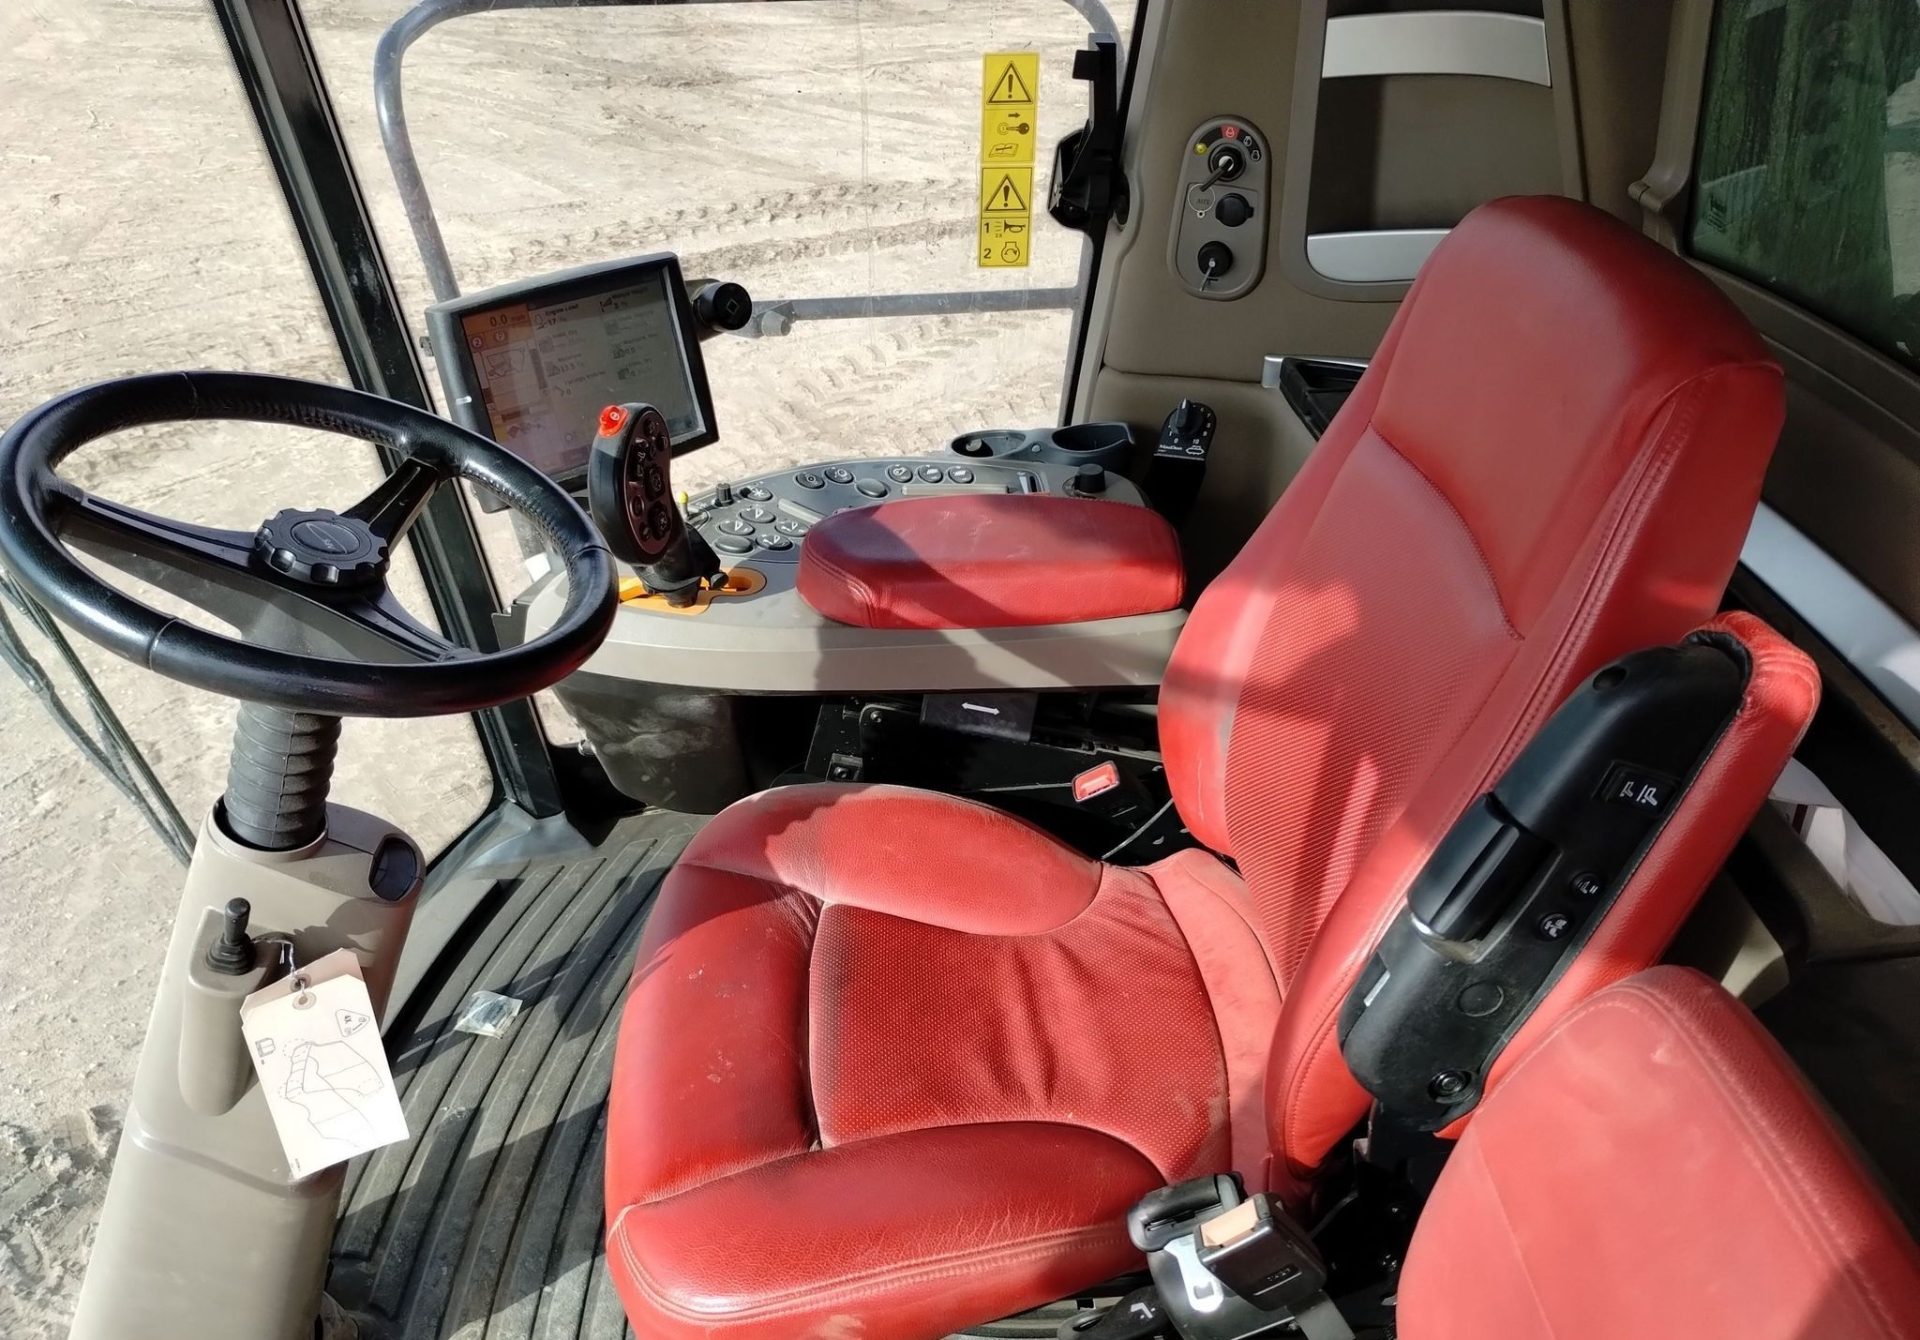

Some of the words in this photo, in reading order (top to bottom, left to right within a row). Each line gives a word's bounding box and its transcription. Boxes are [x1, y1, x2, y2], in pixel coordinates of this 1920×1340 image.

[984, 222, 989, 234] 1
[983, 248, 992, 260] 2
[490, 314, 507, 327] 0.0
